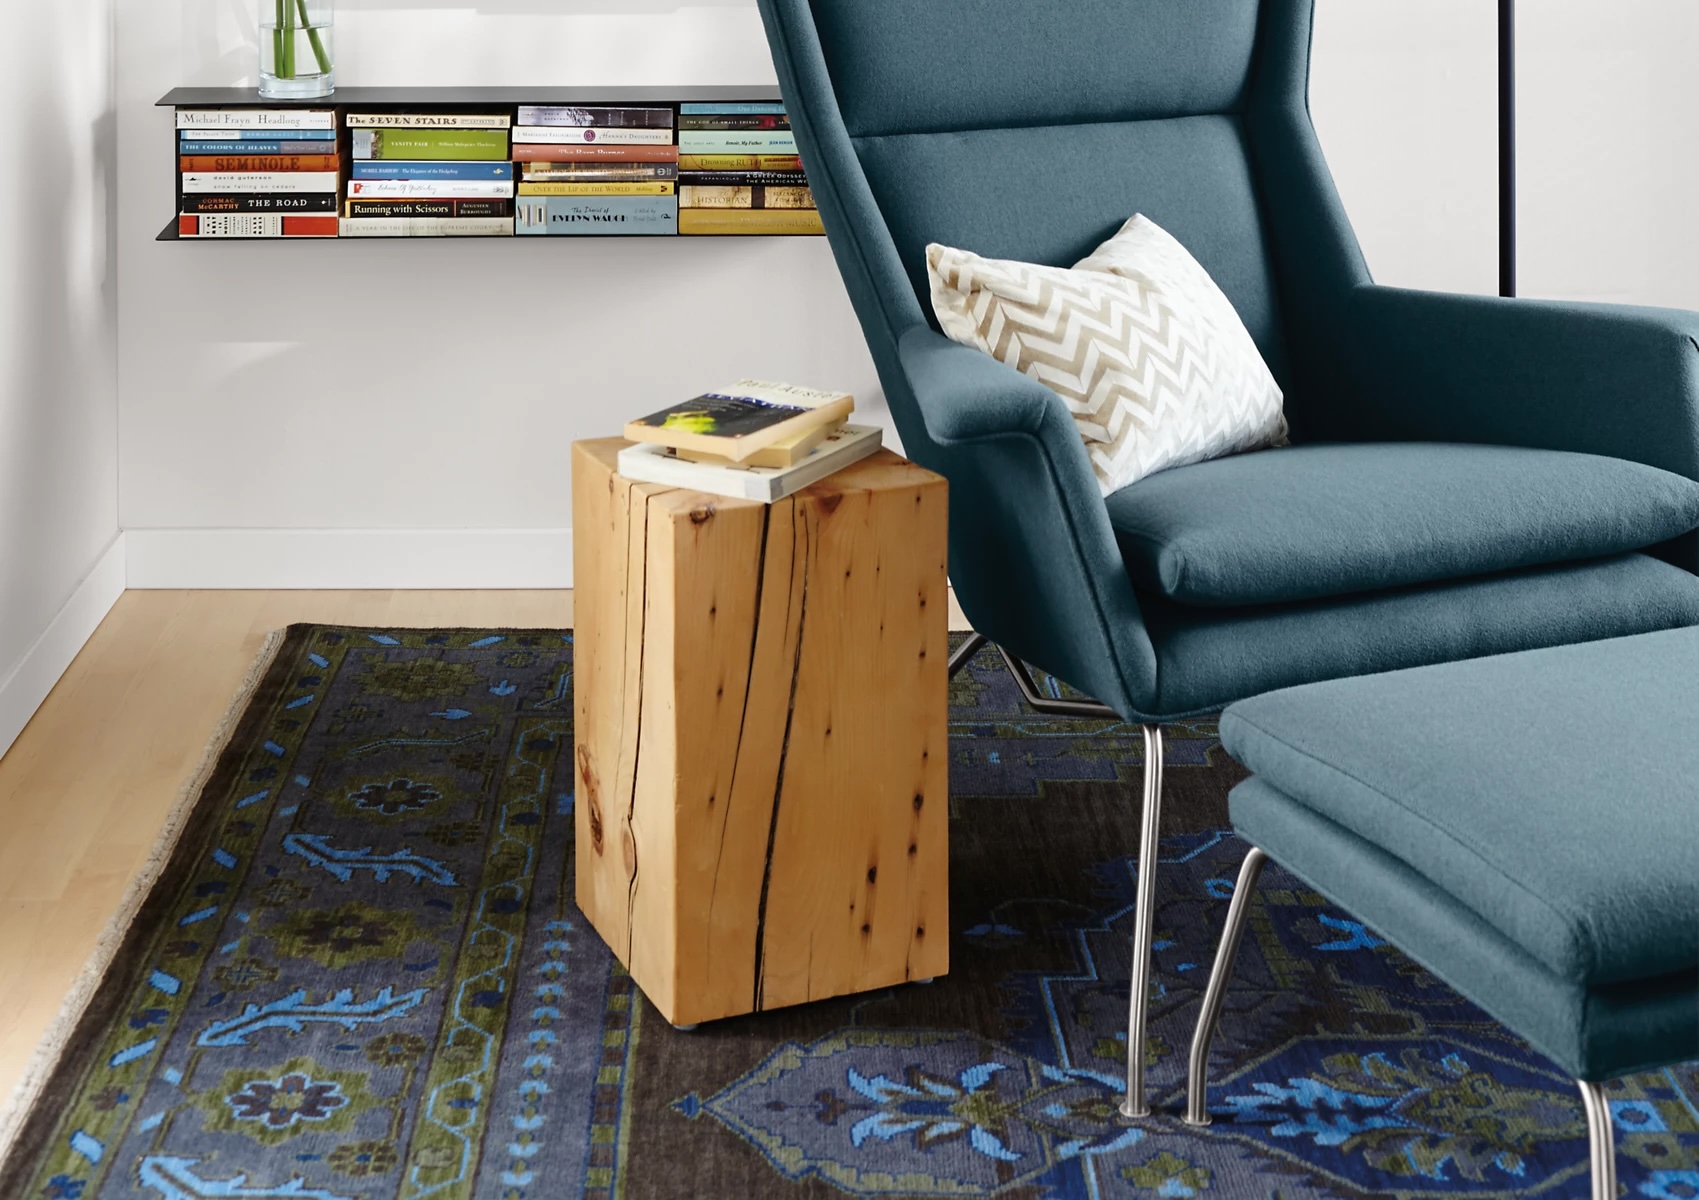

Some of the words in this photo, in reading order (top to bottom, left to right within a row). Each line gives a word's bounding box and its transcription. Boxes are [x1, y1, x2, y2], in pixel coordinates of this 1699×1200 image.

[183, 113, 220, 123] Michael
[224, 113, 250, 127] Frayn
[258, 114, 301, 127] Headlong
[348, 116, 366, 124] The
[369, 116, 411, 125] SEVEN
[414, 117, 457, 125] STAIRS
[215, 157, 300, 171] SEMINOLE
[700, 158, 735, 167] Drowning
[248, 199, 271, 207] THE
[276, 199, 308, 207] ROAD
[697, 196, 747, 204] HISTORIAN
[354, 205, 391, 216] Running
[393, 204, 412, 213] with
[415, 204, 449, 213] Scissors
